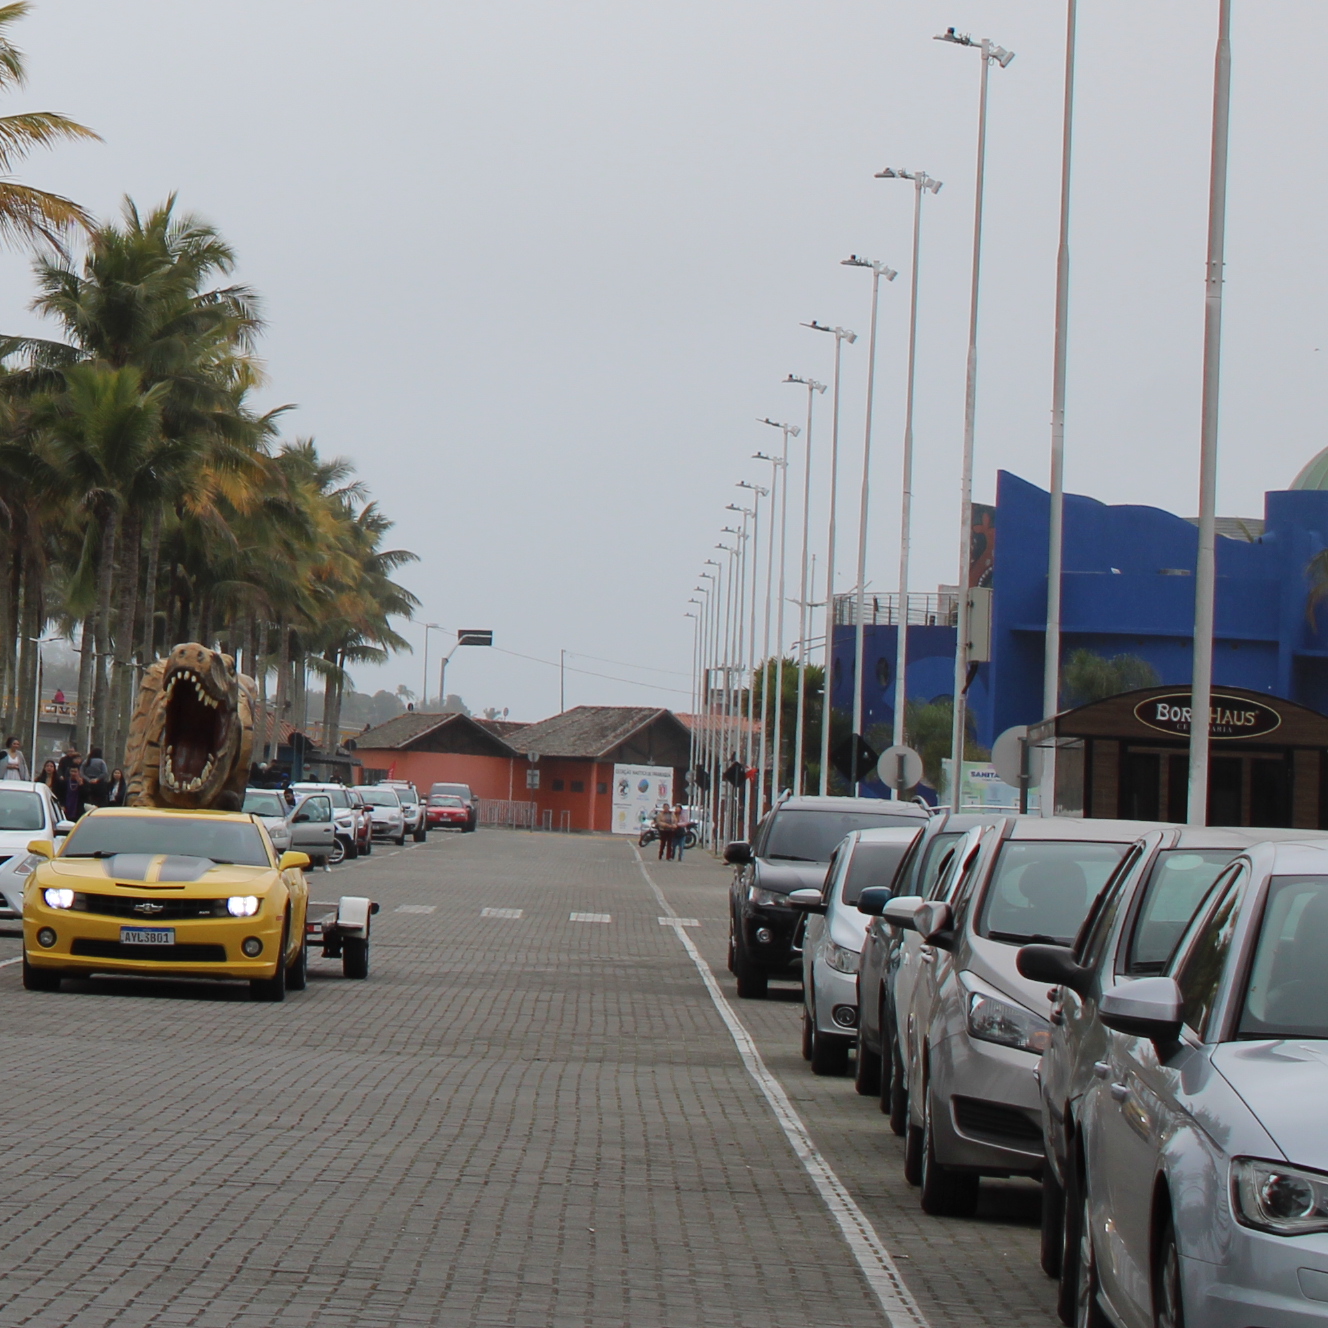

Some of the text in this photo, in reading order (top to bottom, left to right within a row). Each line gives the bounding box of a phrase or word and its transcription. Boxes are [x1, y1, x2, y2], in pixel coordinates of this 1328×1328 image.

[1156, 703, 1255, 726] BORHAUS
[1176, 723, 1233, 733] CEARIA
[125, 932, 170, 943] AYL3B01
